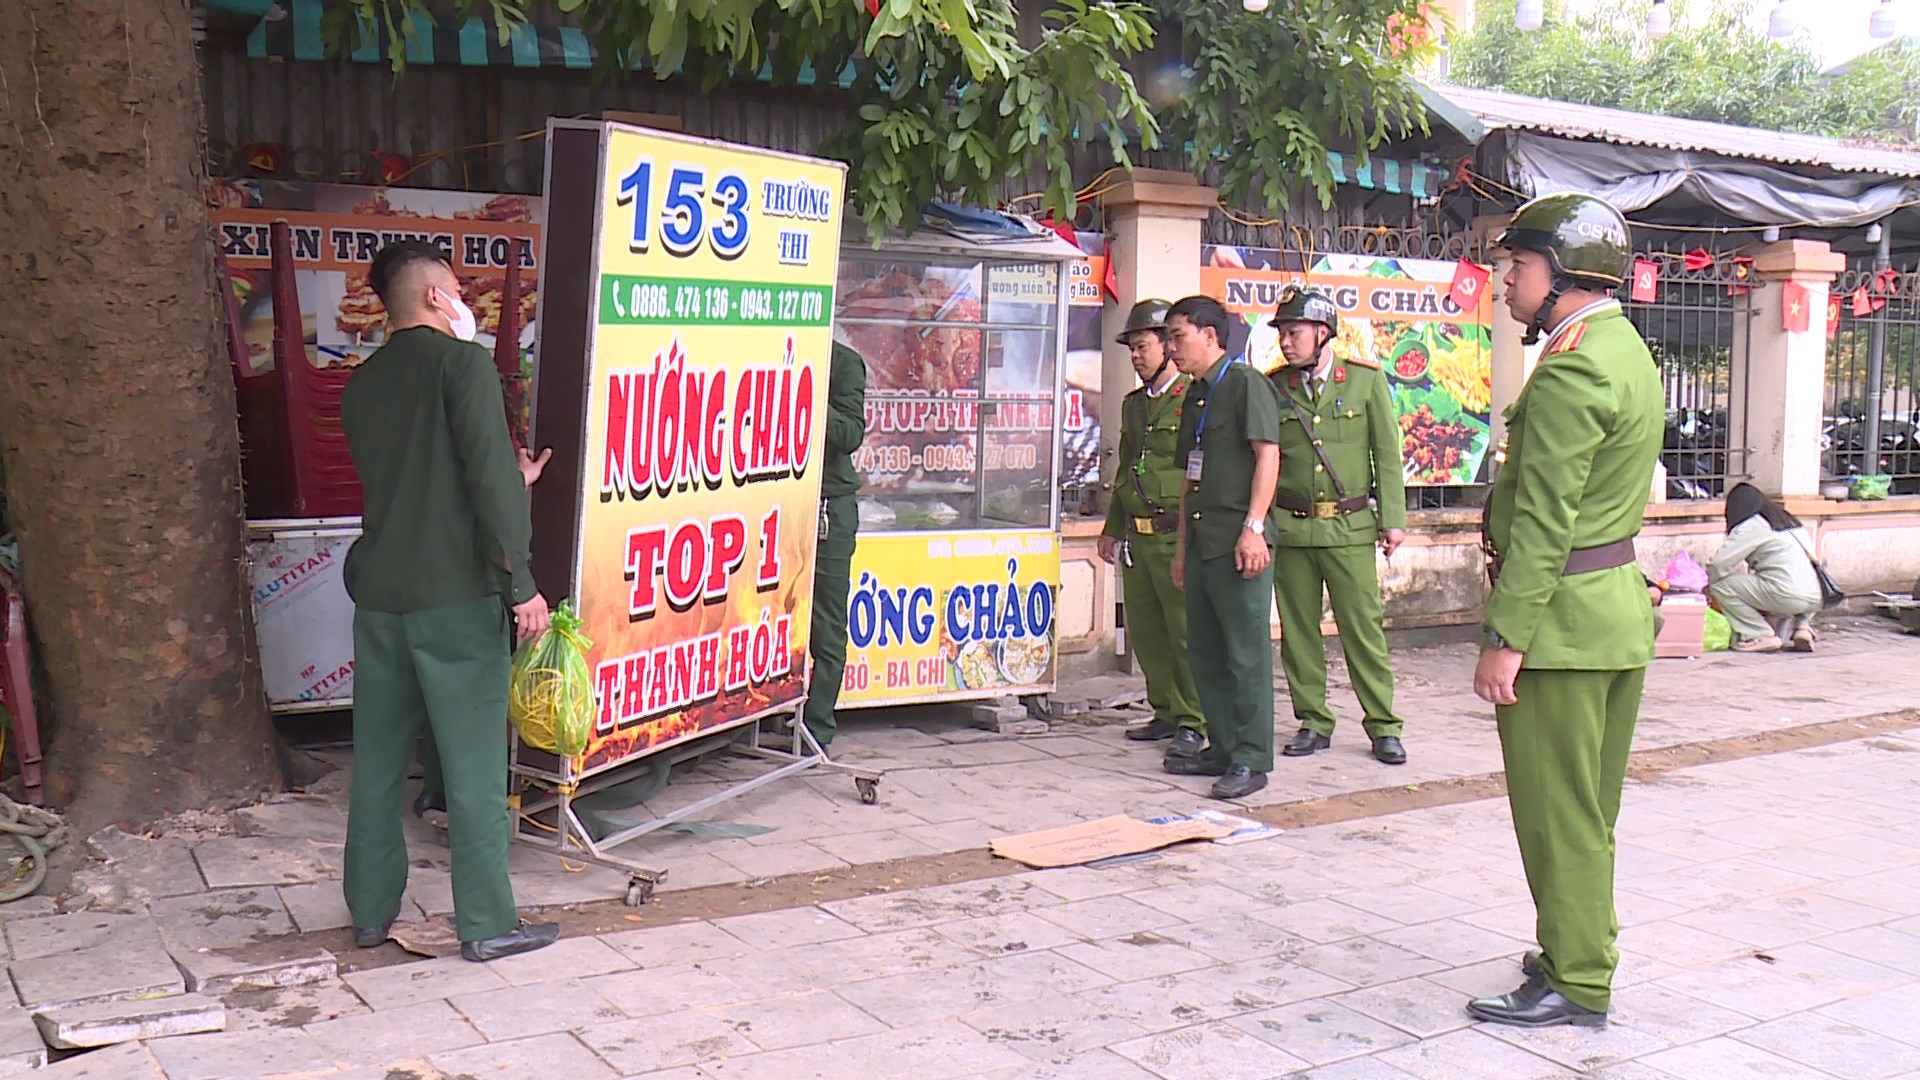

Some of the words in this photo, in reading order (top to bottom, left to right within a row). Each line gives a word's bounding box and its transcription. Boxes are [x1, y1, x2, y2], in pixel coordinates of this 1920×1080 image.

[616, 158, 751, 258] 153
[762, 178, 831, 220] TRƯỜNG
[221, 225, 320, 259] XIN
[779, 230, 810, 264] THI
[631, 283, 671, 318] 0886.
[674, 285, 700, 318] 474
[705, 286, 729, 319] 136
[740, 288, 774, 319] 0943.
[777, 290, 799, 320] 127
[801, 290, 823, 320] 070
[1079, 281, 1098, 297] Hoa
[601, 337, 728, 493] NƯỚNG
[731, 338, 814, 473] CHẢO
[878, 446, 911, 471] 136
[1005, 444, 1036, 469] 070
[627, 514, 747, 618] TOP
[757, 505, 781, 590] 1
[946, 556, 1053, 642] CHẢO
[597, 635, 720, 731] THANH
[725, 610, 791, 692] HÓA
[843, 656, 869, 691] BÒ
[886, 658, 911, 688] BA
[915, 649, 946, 686] CHỈ
